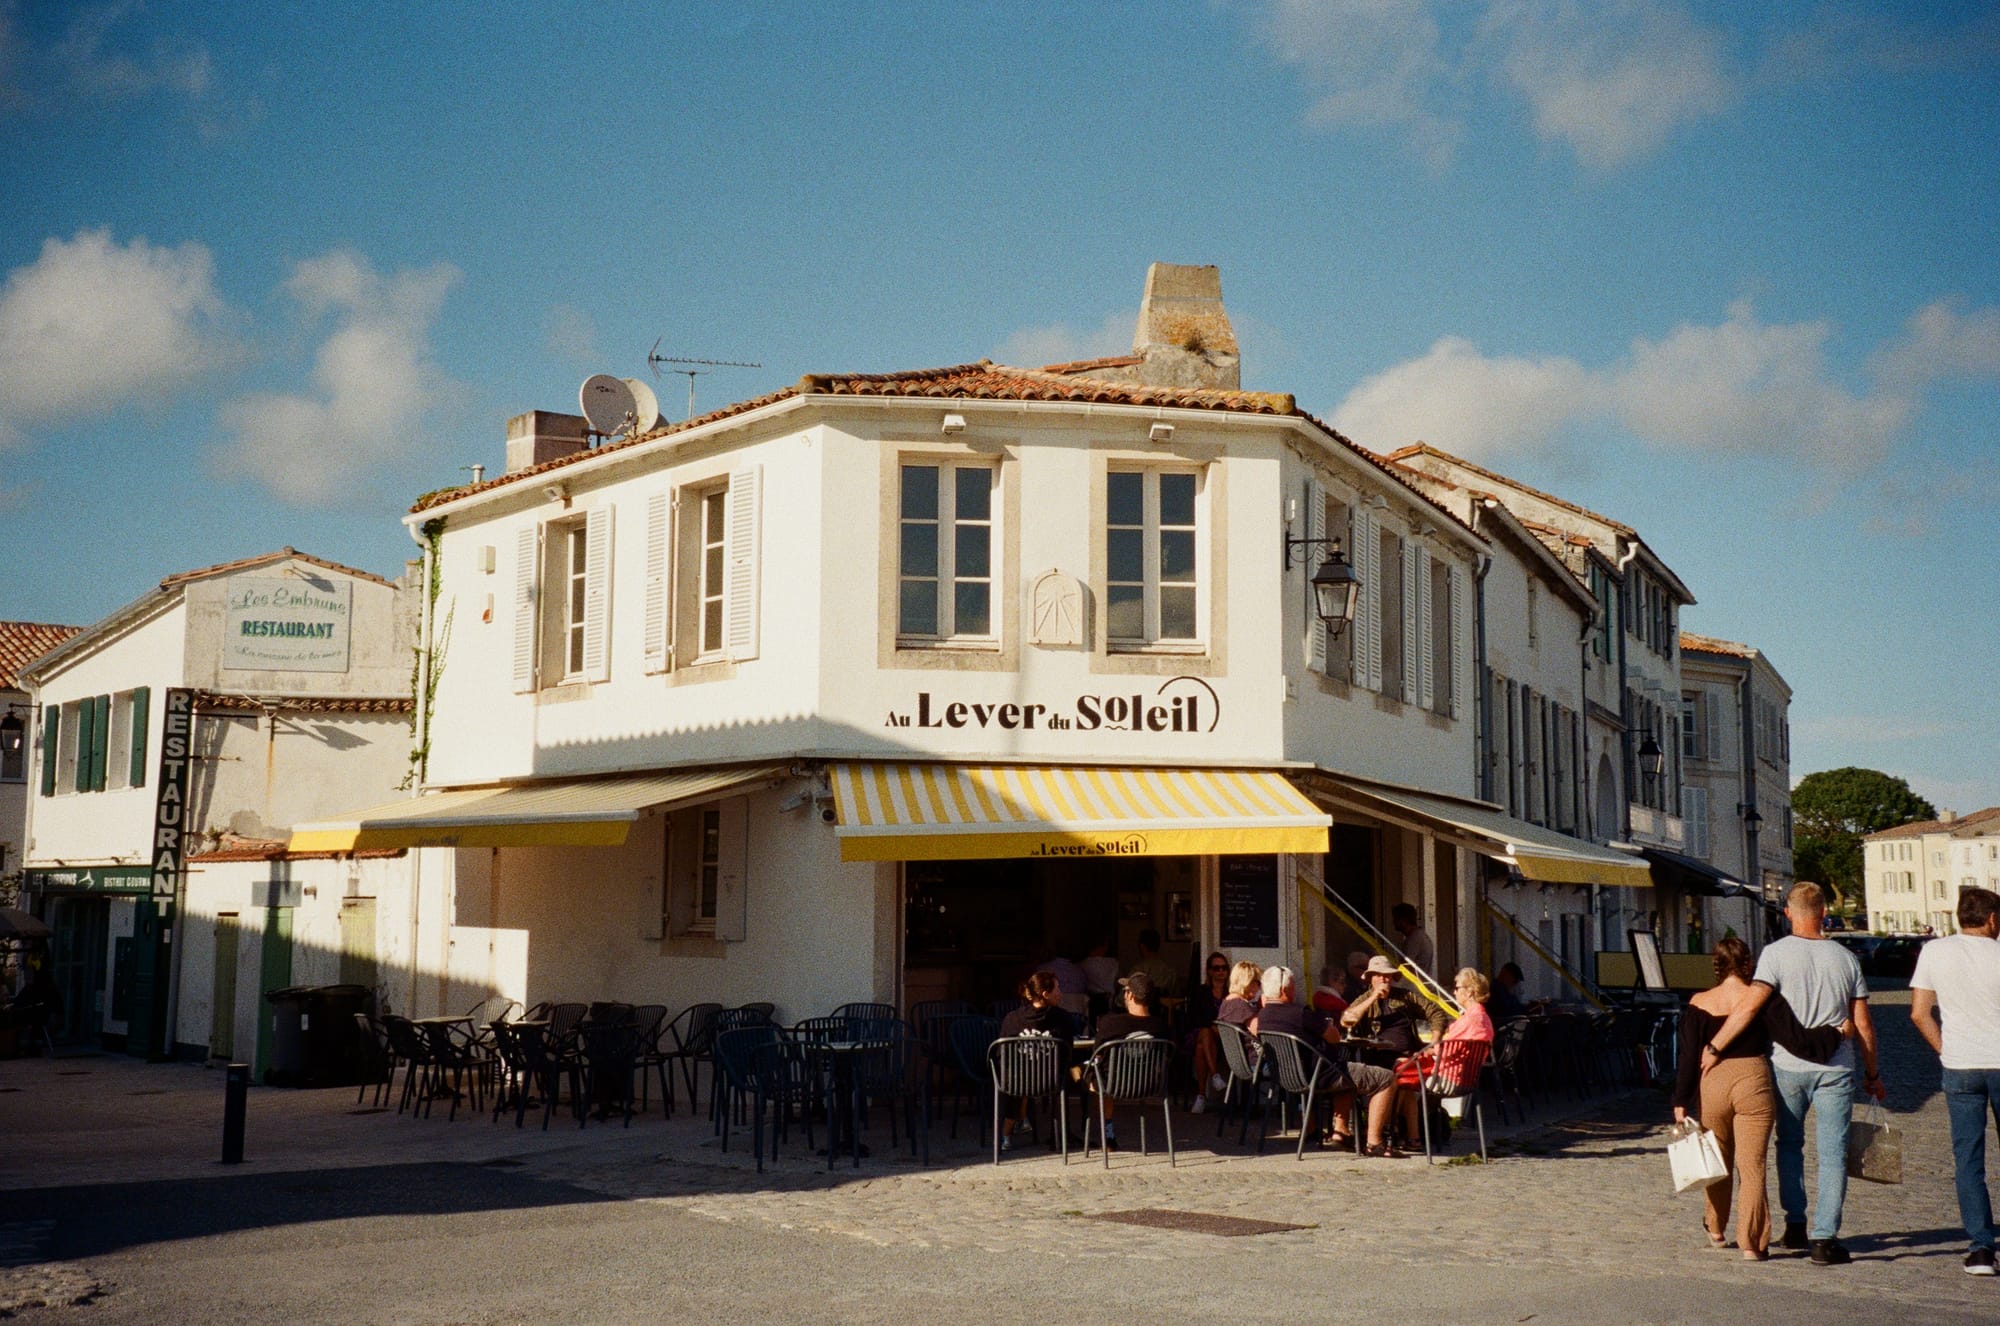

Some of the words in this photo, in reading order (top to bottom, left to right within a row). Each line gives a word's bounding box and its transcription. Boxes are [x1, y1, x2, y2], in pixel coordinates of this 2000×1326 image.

[231, 589, 269, 609] Les
[273, 587, 346, 615] Embruns
[241, 620, 335, 638] RESTAURANT
[885, 710, 911, 728] Au
[917, 692, 1046, 730] Lever
[1048, 713, 1070, 731] du
[1076, 693, 1199, 732] Soleil
[152, 691, 189, 917] RESTAURANT
[1040, 843, 1085, 855] Lever
[1096, 841, 1140, 855] Soleil
